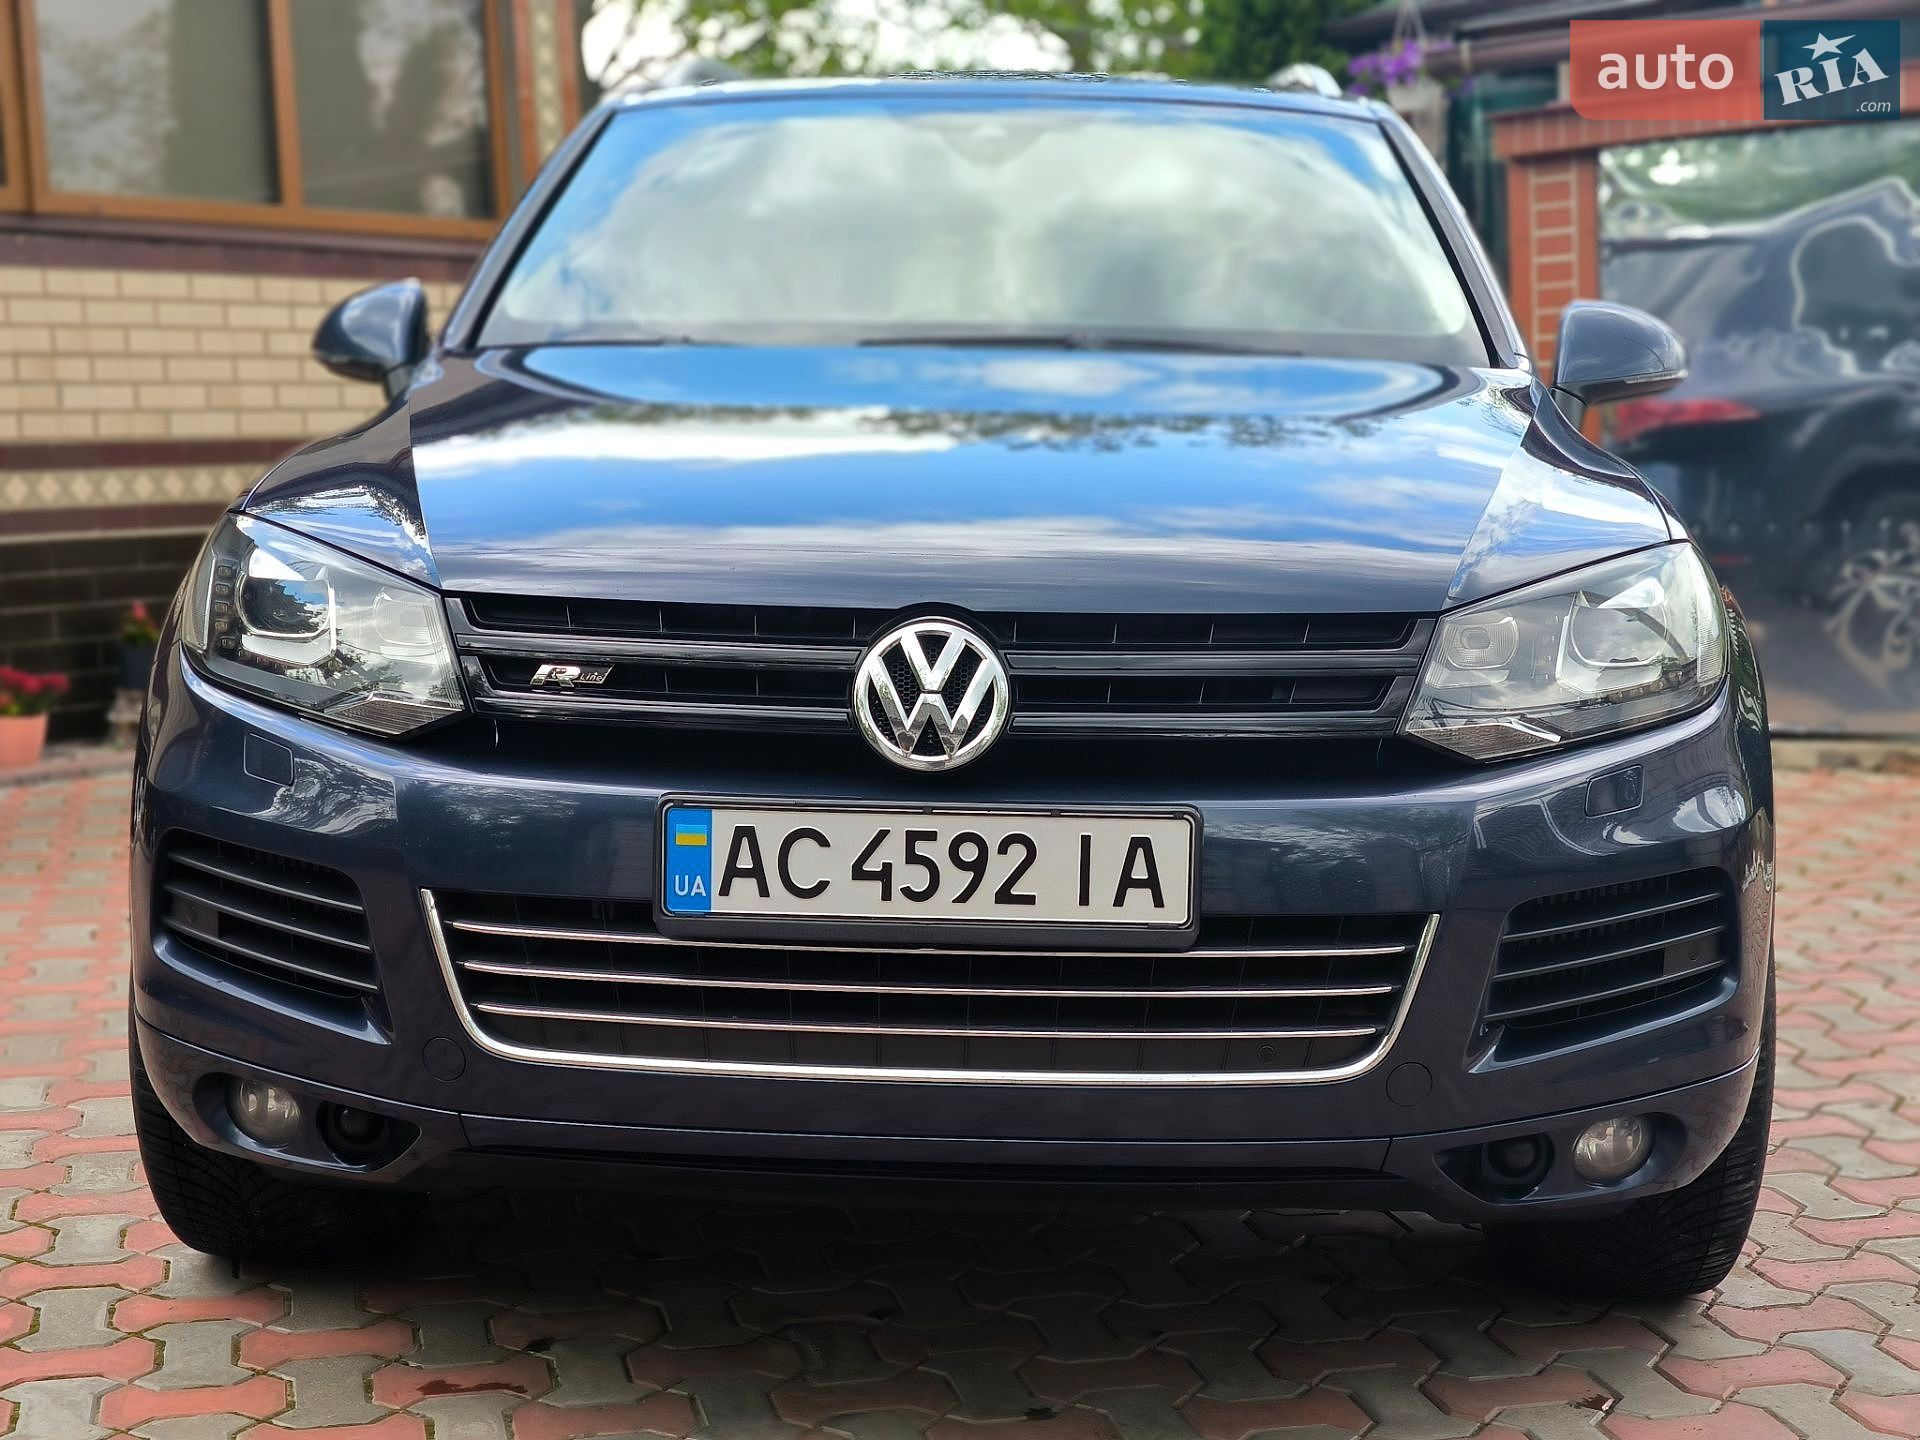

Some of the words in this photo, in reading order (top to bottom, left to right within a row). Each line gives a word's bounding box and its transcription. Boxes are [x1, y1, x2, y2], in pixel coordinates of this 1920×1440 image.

[862, 624, 1002, 763] VW
[675, 874, 706, 897] UA
[718, 825, 831, 899] AC
[851, 828, 1038, 904] 4592
[1078, 834, 1165, 908] IA
